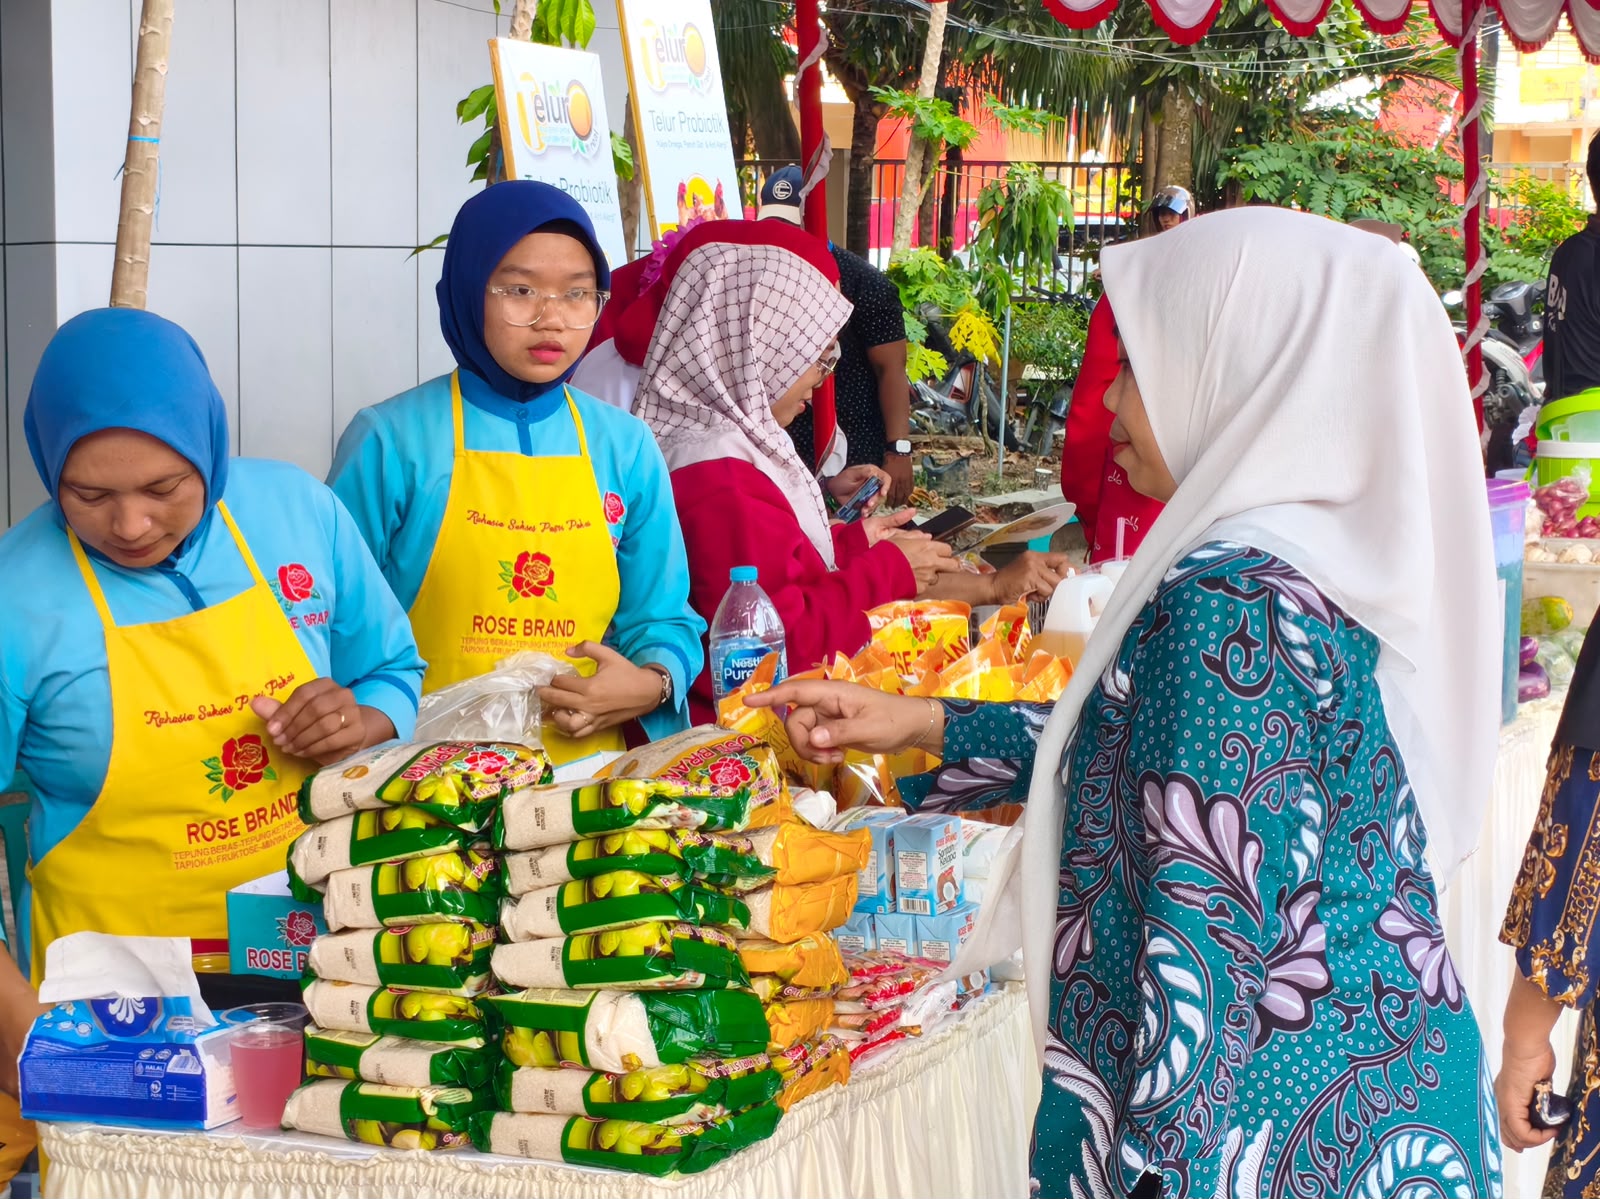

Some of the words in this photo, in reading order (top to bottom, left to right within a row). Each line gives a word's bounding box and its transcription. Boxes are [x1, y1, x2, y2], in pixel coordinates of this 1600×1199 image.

[648, 110, 675, 132] Telur
[678, 111, 725, 133] Probiotik
[560, 177, 613, 204] Probiotik
[466, 510, 504, 527] Rahasia
[508, 518, 537, 532] Sukses
[472, 615, 517, 636] ROSE
[523, 618, 576, 637] BRAND
[144, 710, 195, 728] Rahasia
[198, 704, 234, 721] Sukses
[265, 672, 295, 696] Pakai
[186, 817, 241, 845] ROSE
[244, 791, 298, 833] BRAND
[173, 848, 210, 860] TEPUNG
[246, 947, 294, 971] ROSE
